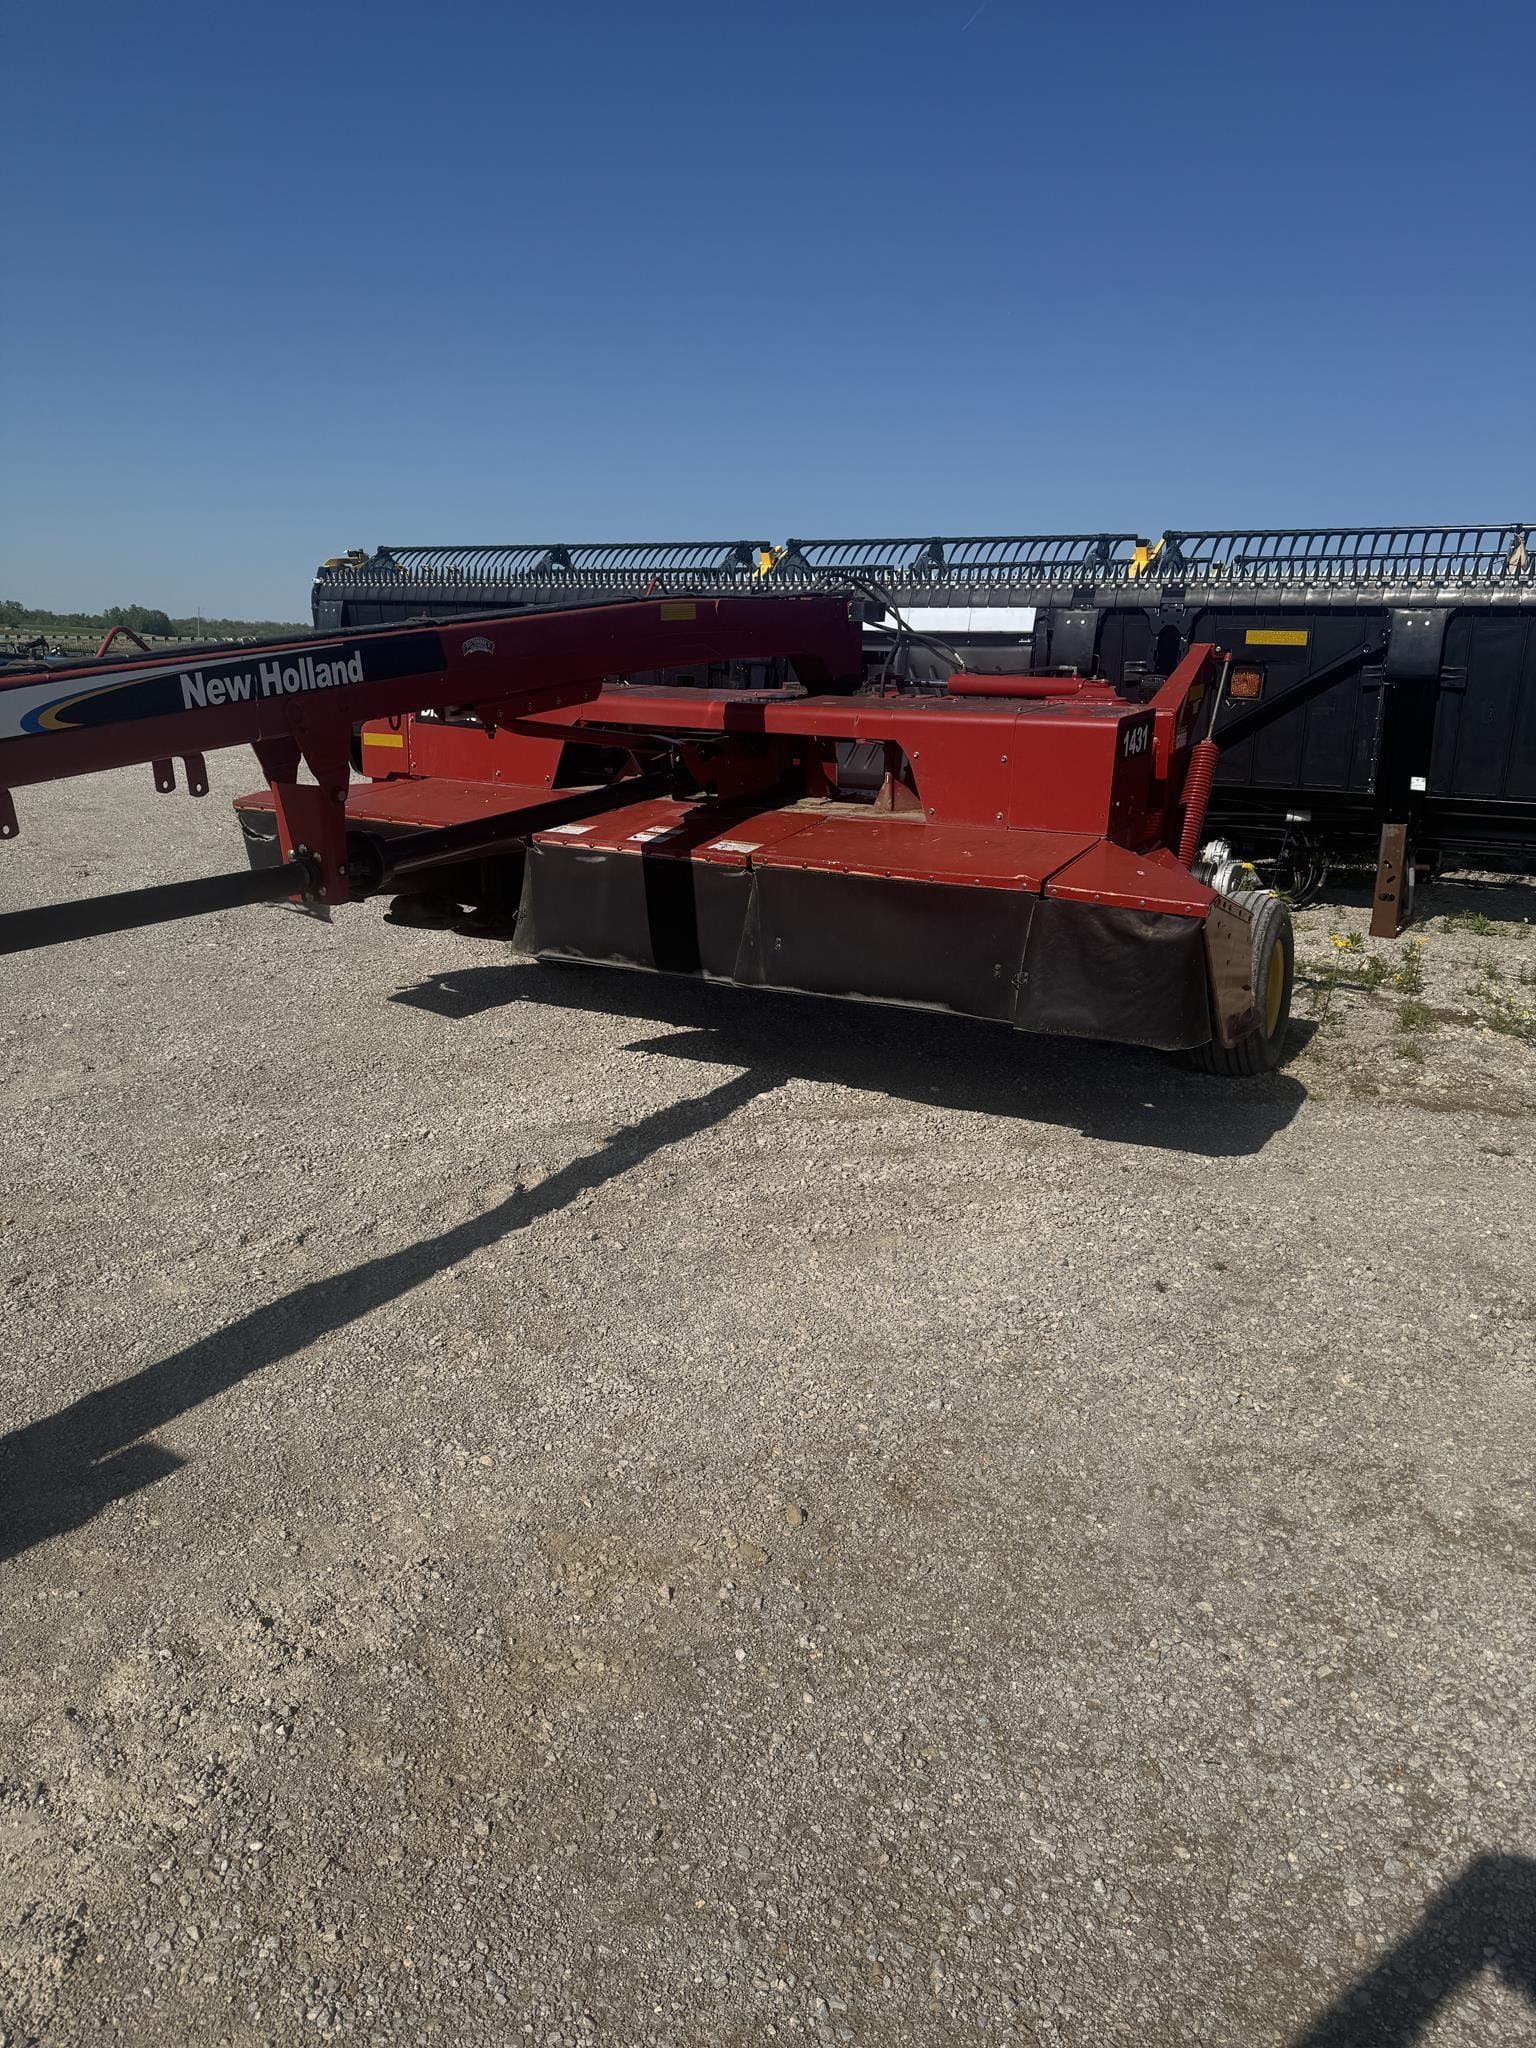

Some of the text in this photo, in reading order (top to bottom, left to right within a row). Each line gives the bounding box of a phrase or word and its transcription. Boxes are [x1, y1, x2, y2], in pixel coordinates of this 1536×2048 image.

[179, 650, 364, 709] New Holland
[1123, 724, 1149, 757] 1431
